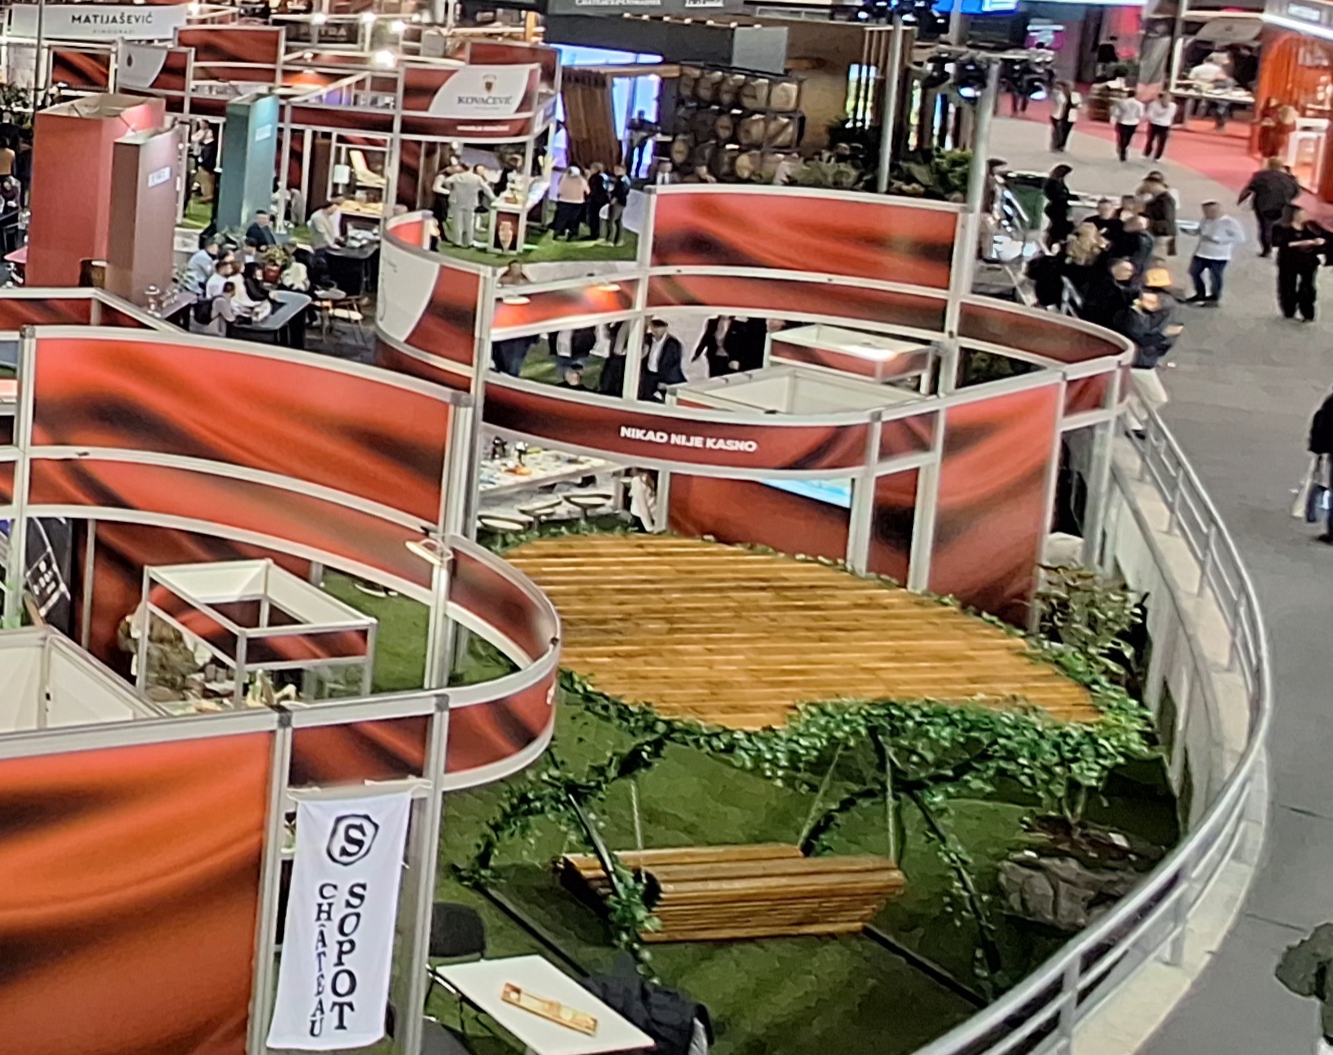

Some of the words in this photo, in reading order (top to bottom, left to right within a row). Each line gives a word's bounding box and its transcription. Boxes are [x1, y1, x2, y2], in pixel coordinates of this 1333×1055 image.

[71, 13, 153, 25] MATIJAŠEVIĆ
[457, 94, 513, 106] KOVAČEVIĆ
[620, 426, 668, 443] NIKAD
[670, 433, 704, 448] NIJE
[706, 438, 758, 452] KASNO
[329, 882, 368, 1031] SOPOT
